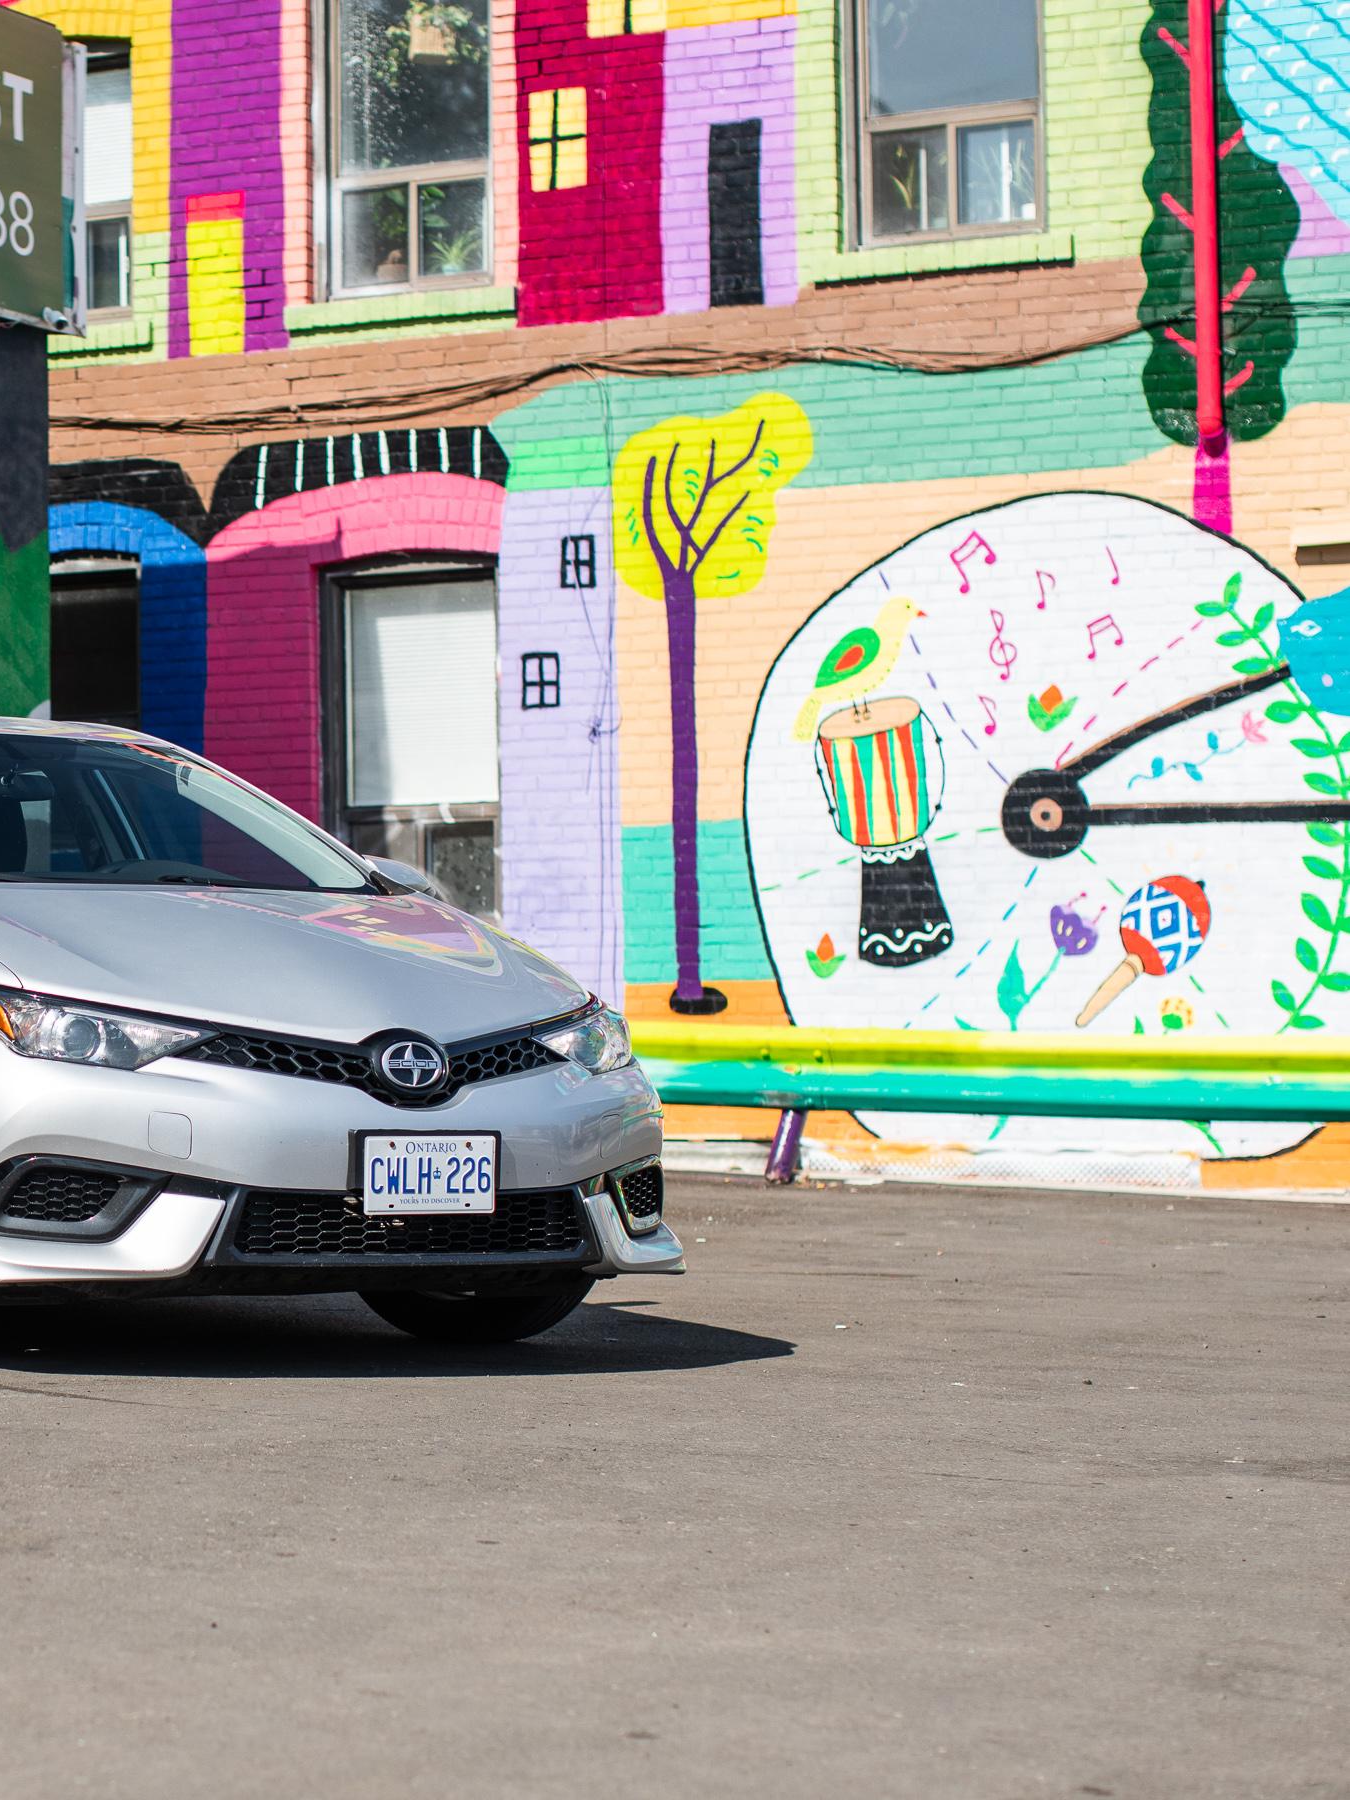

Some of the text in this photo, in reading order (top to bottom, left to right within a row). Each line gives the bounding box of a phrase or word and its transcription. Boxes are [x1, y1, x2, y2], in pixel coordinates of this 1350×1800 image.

[388, 1060, 438, 1068] SCION
[406, 1142, 457, 1155] ONTARIO
[370, 1157, 491, 1195] CWLH 226
